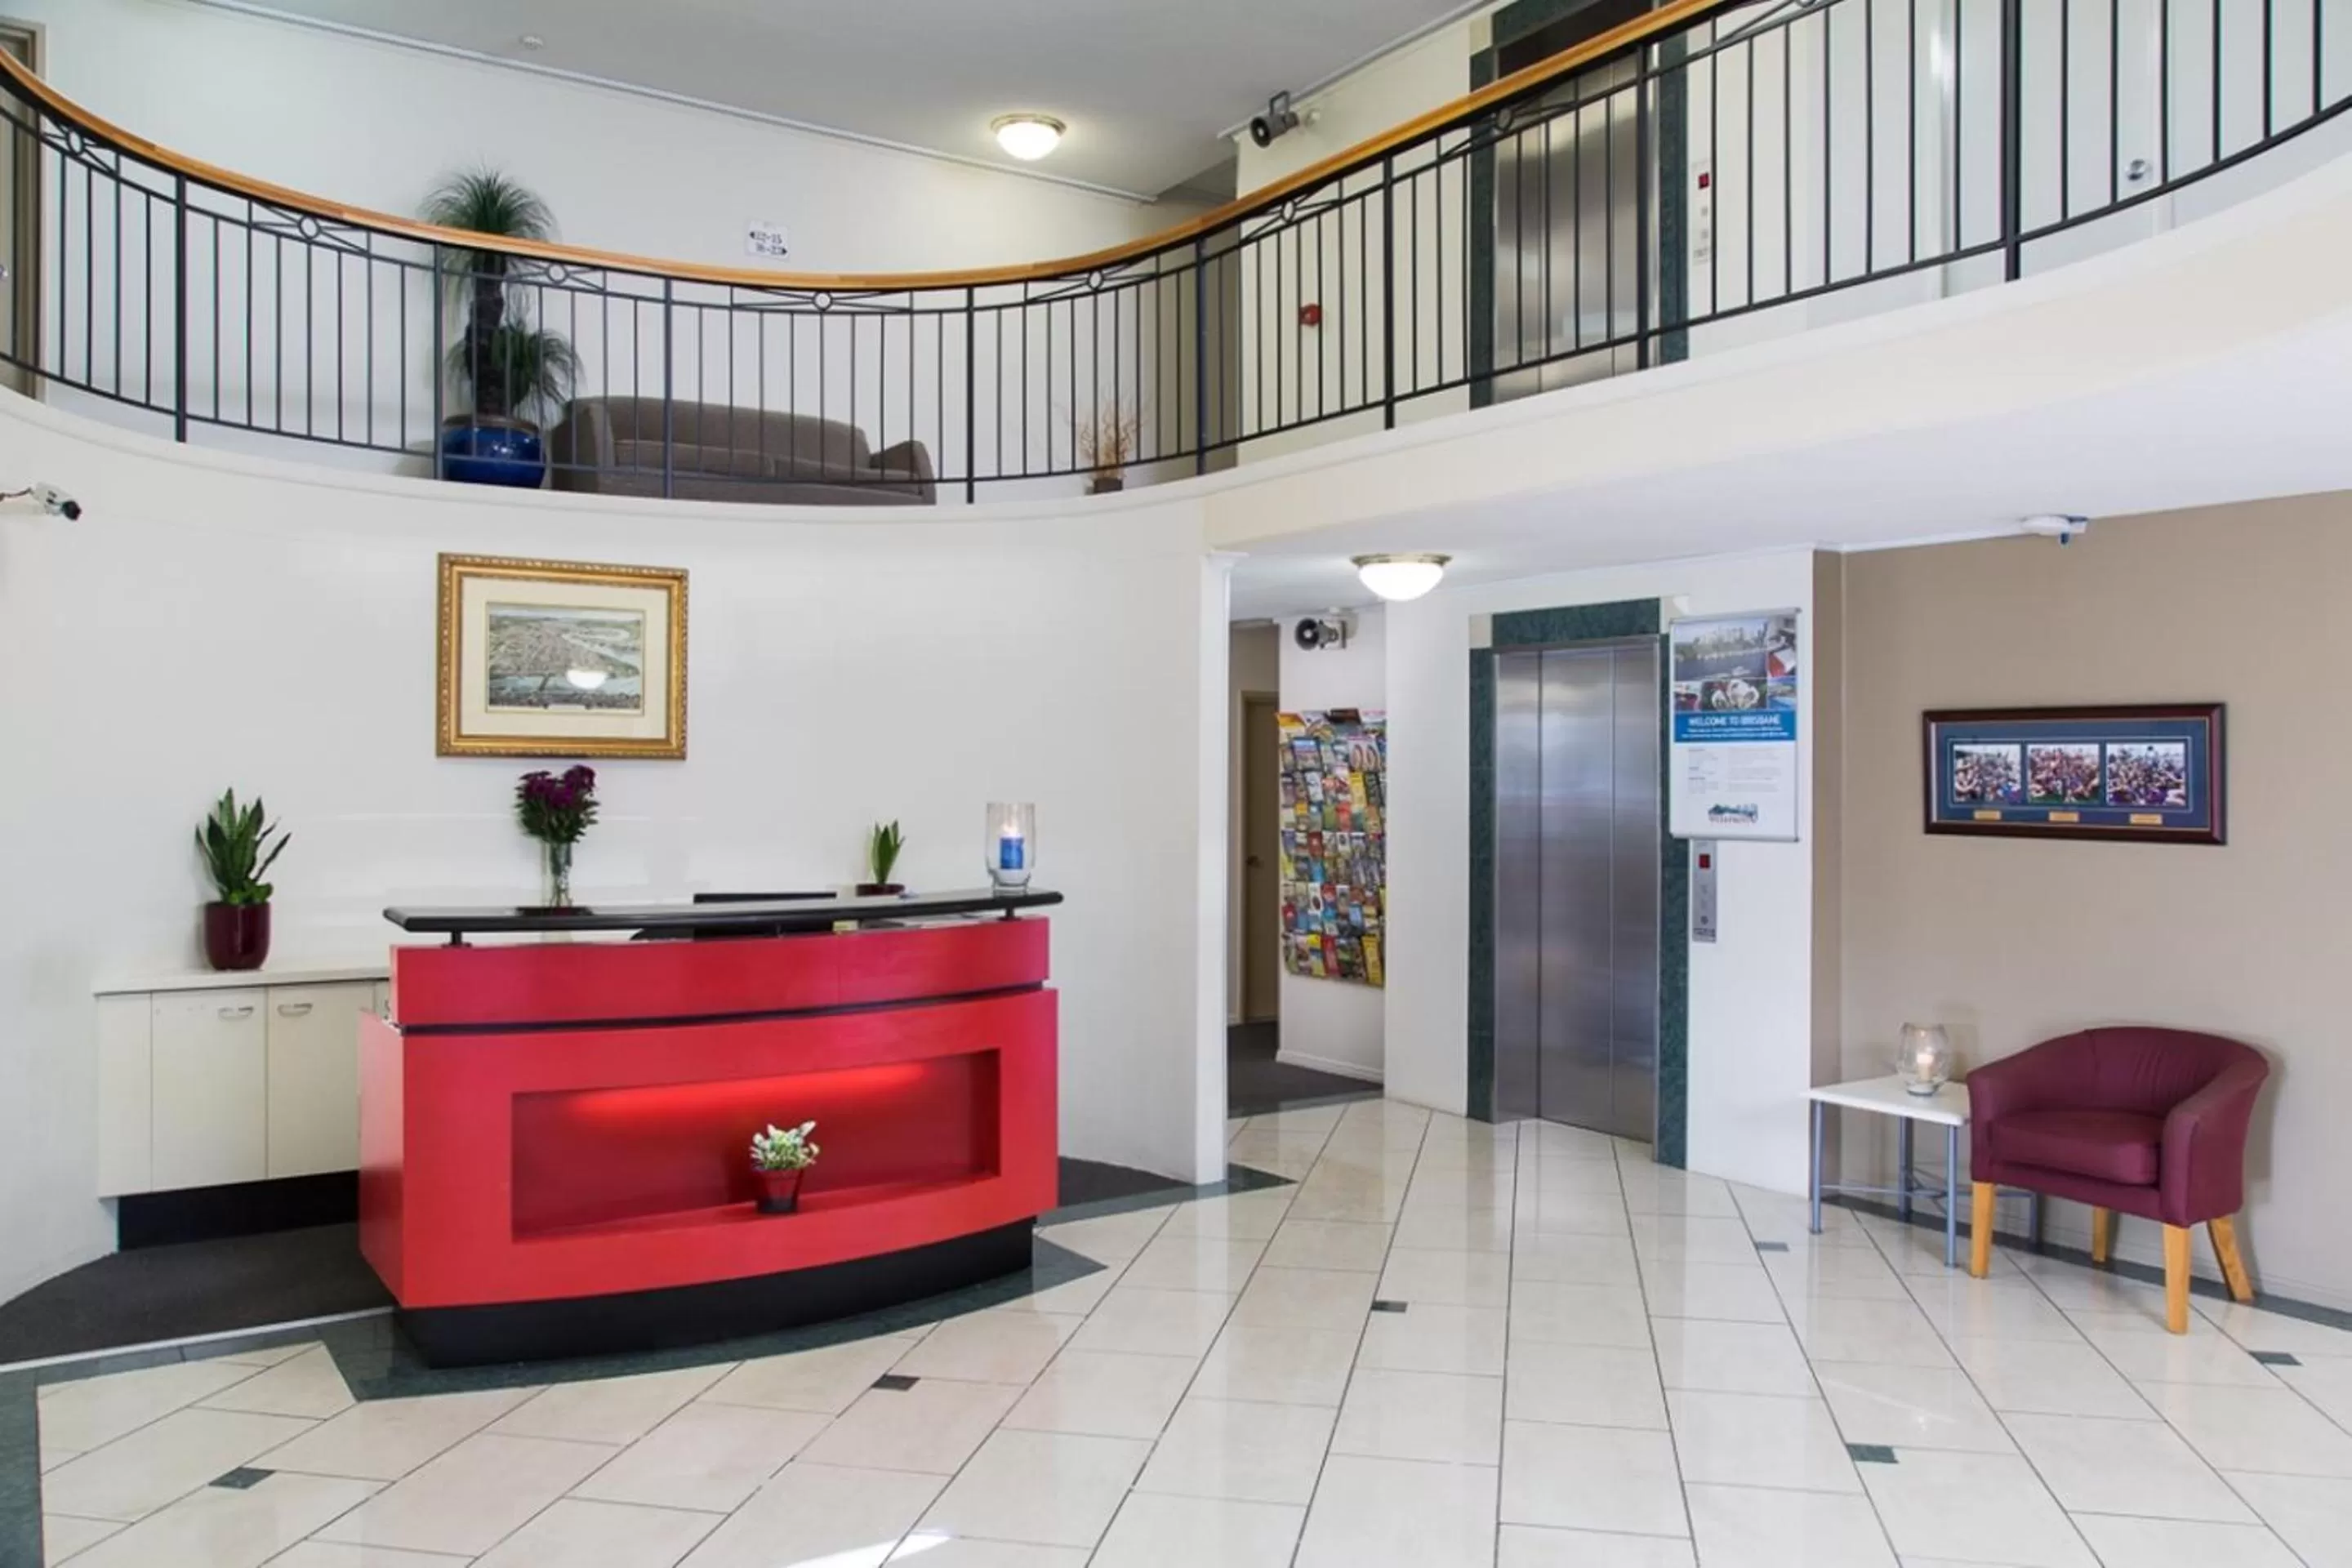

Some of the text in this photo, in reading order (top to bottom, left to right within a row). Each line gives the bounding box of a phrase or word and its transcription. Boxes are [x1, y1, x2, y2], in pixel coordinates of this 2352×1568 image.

[1688, 714, 1780, 726] WELCOME TO BRISBANE
